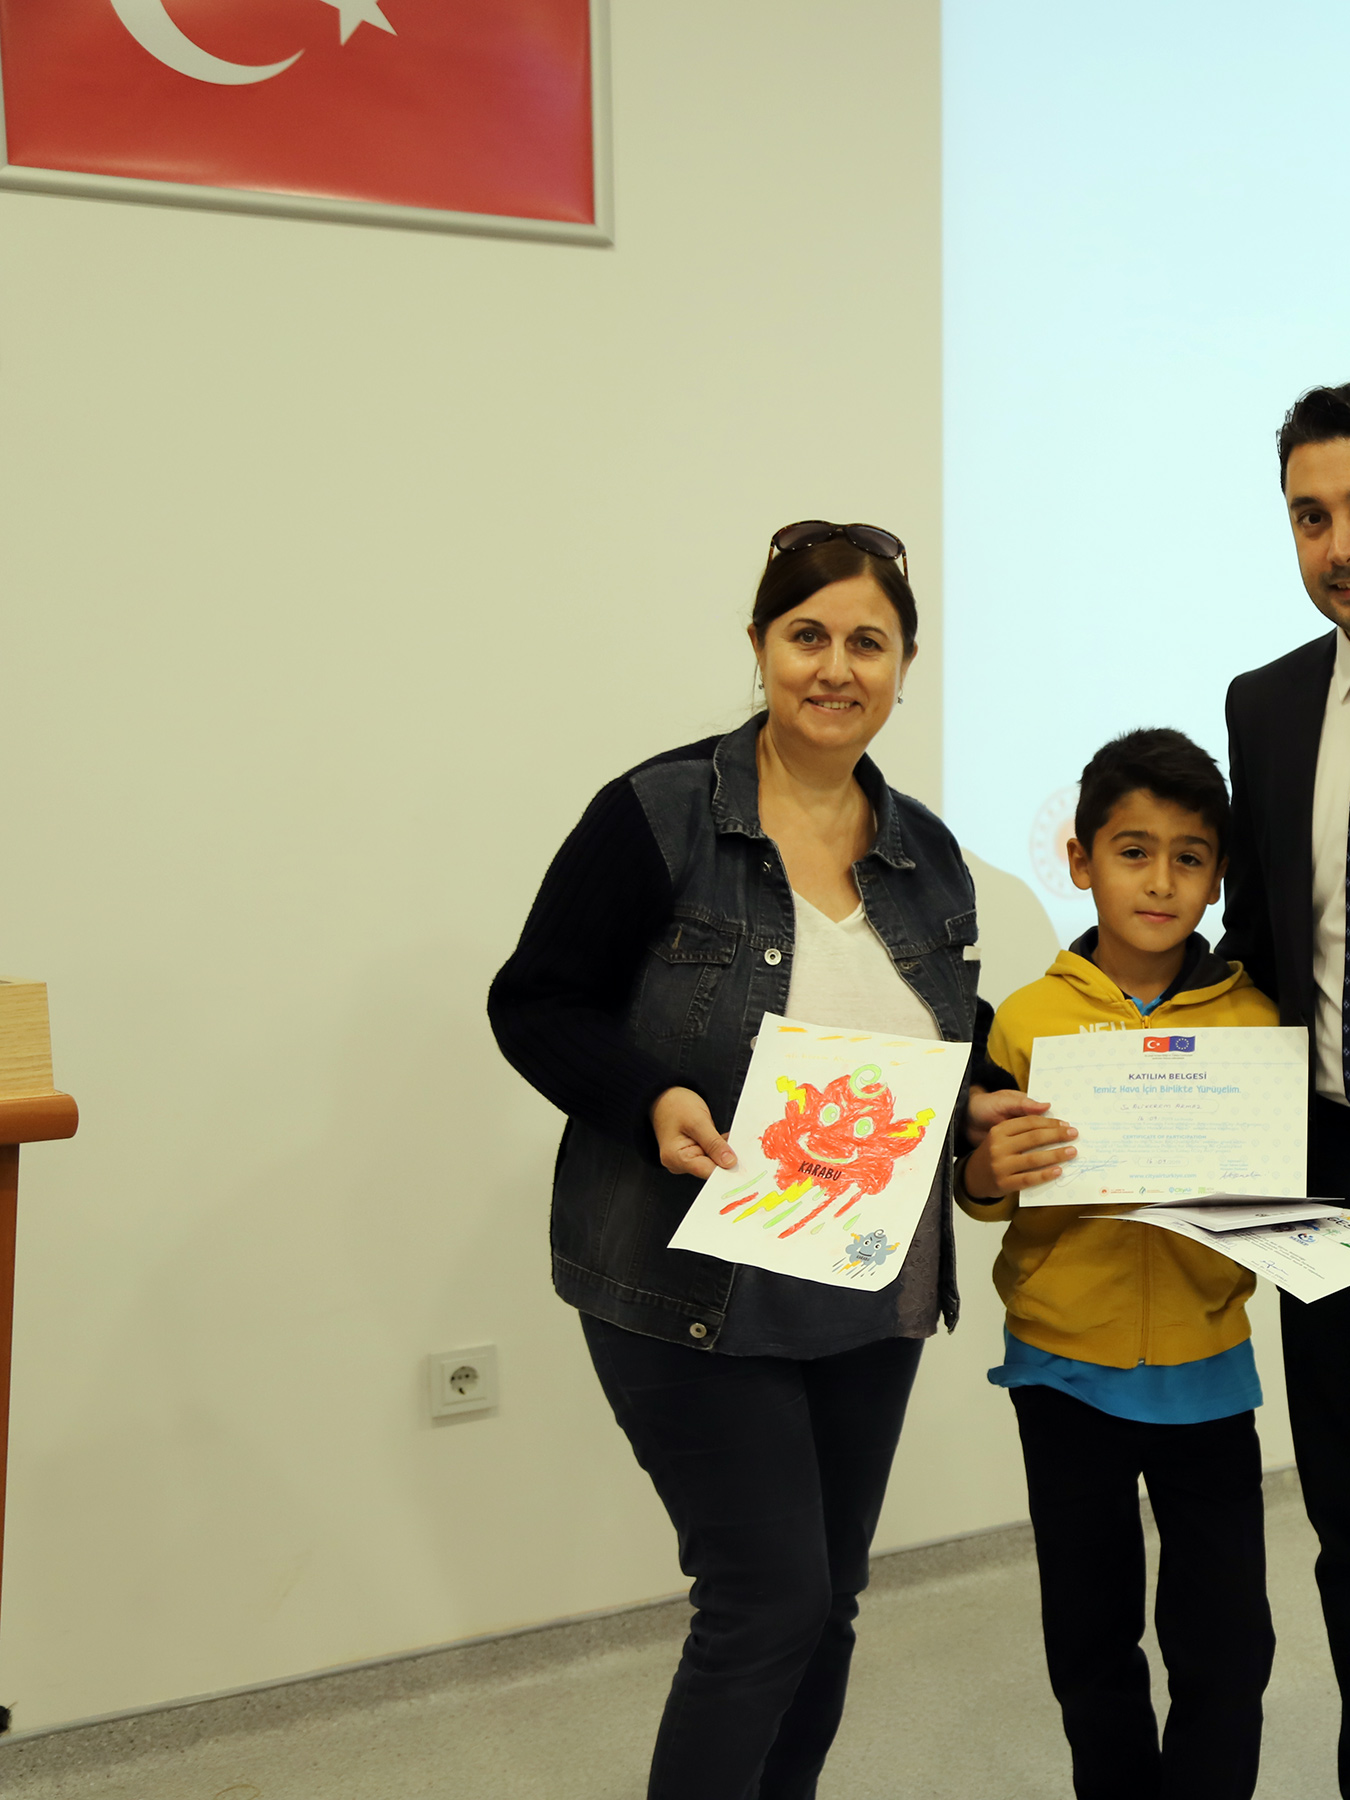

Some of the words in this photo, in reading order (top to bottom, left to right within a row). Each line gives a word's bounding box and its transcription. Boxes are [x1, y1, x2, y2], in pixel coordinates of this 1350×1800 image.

[1169, 1071, 1207, 1080] BELGESİ
[1093, 1085, 1117, 1094] Temiz
[1119, 1085, 1140, 1093] Hava
[1142, 1084, 1158, 1095] İçin
[1160, 1085, 1193, 1093] Birlikte
[798, 1160, 842, 1182] KARABU
